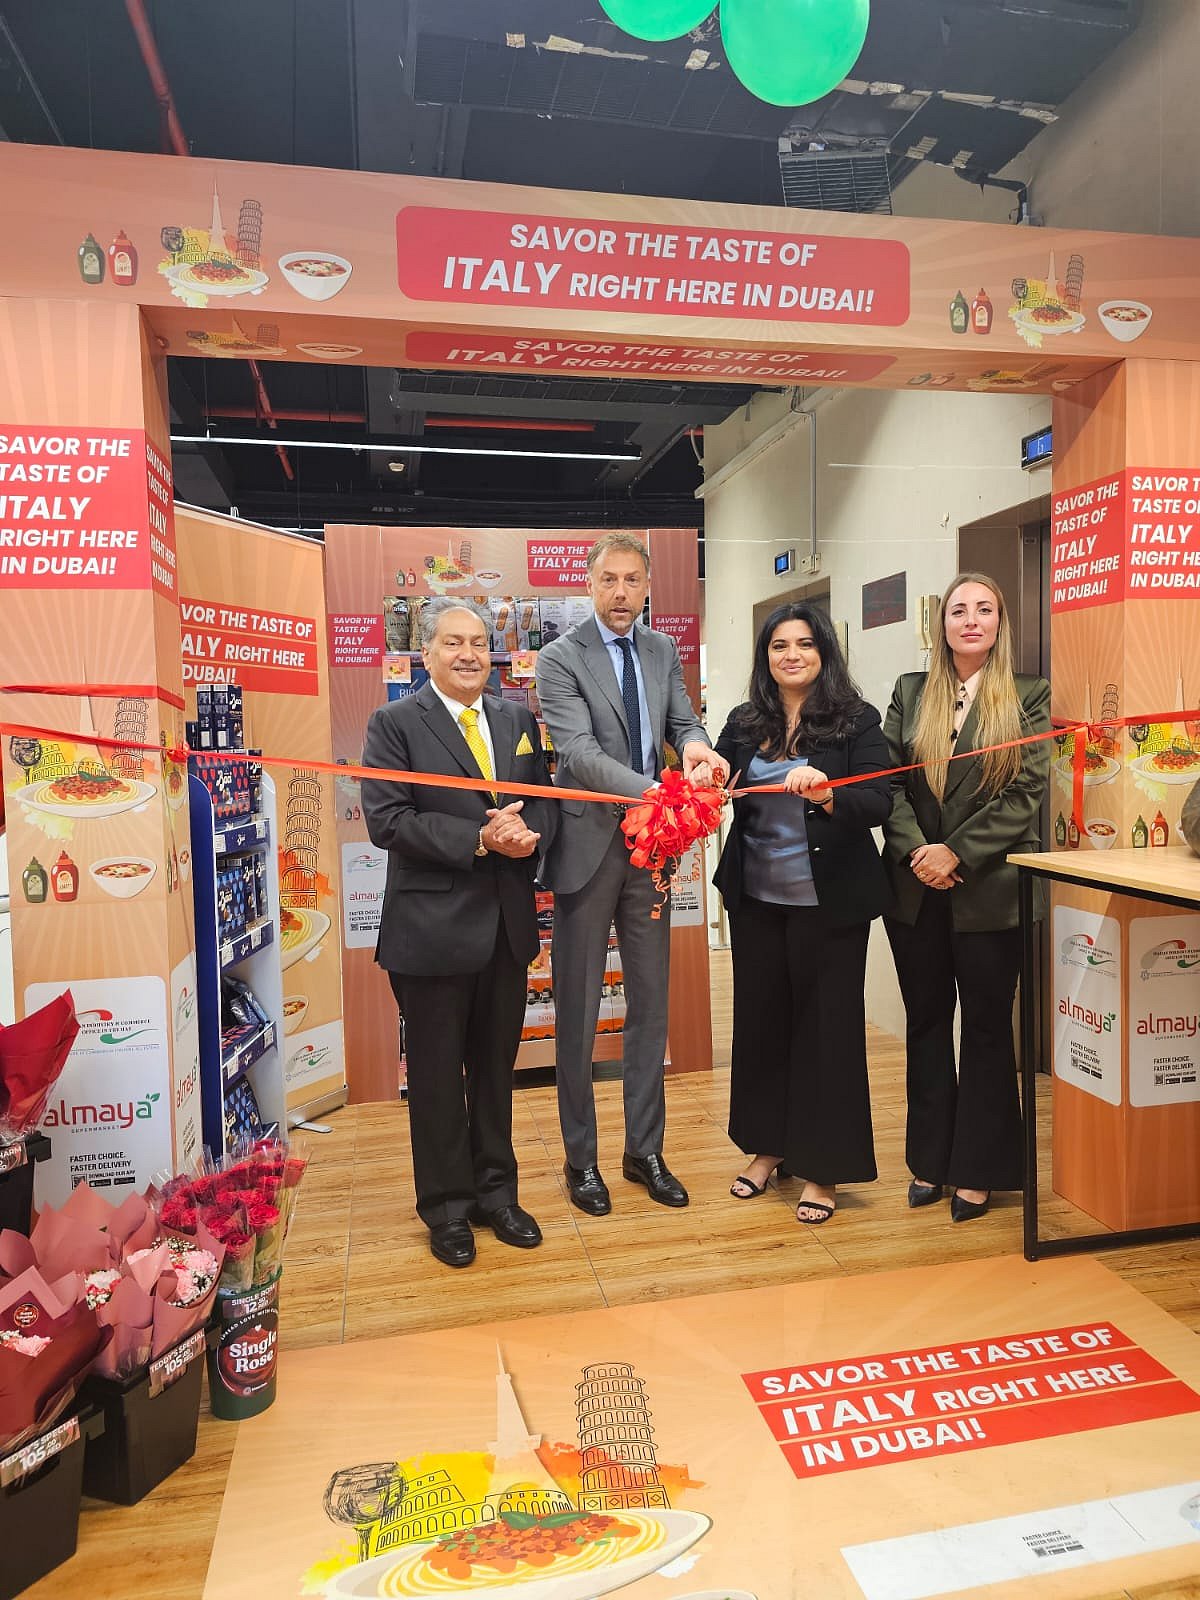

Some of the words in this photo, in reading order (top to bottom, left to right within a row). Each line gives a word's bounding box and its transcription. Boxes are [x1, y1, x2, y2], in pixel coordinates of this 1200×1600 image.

[510, 224, 616, 255] SAVOR
[625, 232, 676, 259] THE
[684, 236, 772, 265] TASTE
[778, 242, 817, 267] OF
[443, 256, 562, 296] ITALY
[569, 272, 661, 301] RIGHT
[666, 279, 735, 306] HERE
[743, 283, 774, 308] IN
[778, 286, 874, 314] DUBAI!
[446, 349, 557, 366] ITALY
[561, 357, 644, 370] RIGHT
[648, 362, 720, 374] HERE
[719, 365, 749, 375] IN
[749, 367, 847, 379] DUBAI!
[512, 340, 614, 355] SAVOR
[624, 345, 677, 359] THE
[678, 348, 767, 362] TASTE
[766, 353, 809, 364] OF
[0, 436, 80, 456] SAVOR
[86, 439, 132, 457] THE
[0, 464, 71, 483] TASTE
[77, 466, 110, 484] OF
[1132, 476, 1188, 492] SAVOR
[148, 471, 163, 502] TASTE
[163, 490, 169, 507] OF
[1055, 493, 1094, 515] SAVOR
[1097, 481, 1120, 502] THE
[0, 496, 91, 520] ITALY
[1132, 498, 1182, 514] TASTE
[149, 502, 167, 537] ITALY
[1055, 513, 1089, 536] TASTE
[1090, 507, 1108, 524] OF
[0, 530, 75, 548] RIGHT
[79, 530, 139, 549] HERE
[1130, 524, 1193, 544] ITALY
[531, 546, 564, 555] SAVOR
[567, 546, 586, 555] THE
[1054, 534, 1098, 563] ITALY
[1130, 551, 1180, 566] RIGHT
[1182, 552, 1200, 567] HE
[1, 557, 27, 574] IN
[32, 557, 117, 575] DUBAI!
[533, 557, 571, 568] ITALY
[572, 560, 588, 568] RIG
[1054, 563, 1089, 583] RIGHT
[1089, 555, 1120, 575] HERE
[559, 574, 569, 582] IN
[1130, 573, 1148, 588] IN
[1151, 573, 1200, 588] DUBAI
[1054, 588, 1066, 603] IN
[1067, 578, 1108, 601] DUBAI!
[181, 604, 215, 624] VOR
[219, 609, 248, 628] THE
[251, 614, 292, 635] TASTE
[295, 620, 313, 637] OF
[333, 617, 362, 625] SAVOR
[363, 617, 378, 625] THE
[182, 633, 222, 657] ALY
[225, 644, 270, 663] RIGHT
[272, 650, 305, 667] HERE
[334, 636, 364, 645] ITALY
[183, 664, 236, 684] DUBAI!
[1136, 1013, 1200, 1037] almay
[69, 1154, 96, 1163] FASTER
[97, 1151, 126, 1160] CHOICE.
[70, 1163, 97, 1172] FASTER
[98, 1160, 131, 1170] DELIVERY
[231, 1294, 260, 1306] SINGLE
[243, 1302, 257, 1315] 12
[149, 1349, 179, 1373] TEDDY'S
[178, 1327, 205, 1353] SPECIAL
[229, 1331, 277, 1358] Single
[165, 1354, 183, 1375] 105
[235, 1350, 274, 1373] Rose
[761, 1362, 888, 1395] SAVOR
[890, 1350, 956, 1376] THE
[957, 1335, 1067, 1365] TASTE
[1068, 1328, 1113, 1350] OF
[781, 1390, 917, 1436] ITALY
[933, 1377, 1039, 1412] RIGHT
[1044, 1363, 1137, 1393] HERE
[0, 1440, 40, 1469] TEDDY'S
[40, 1418, 79, 1442] SPECIAL
[800, 1439, 845, 1467] IN
[854, 1417, 987, 1460] DUBAI!
[19, 1446, 46, 1471] 105
